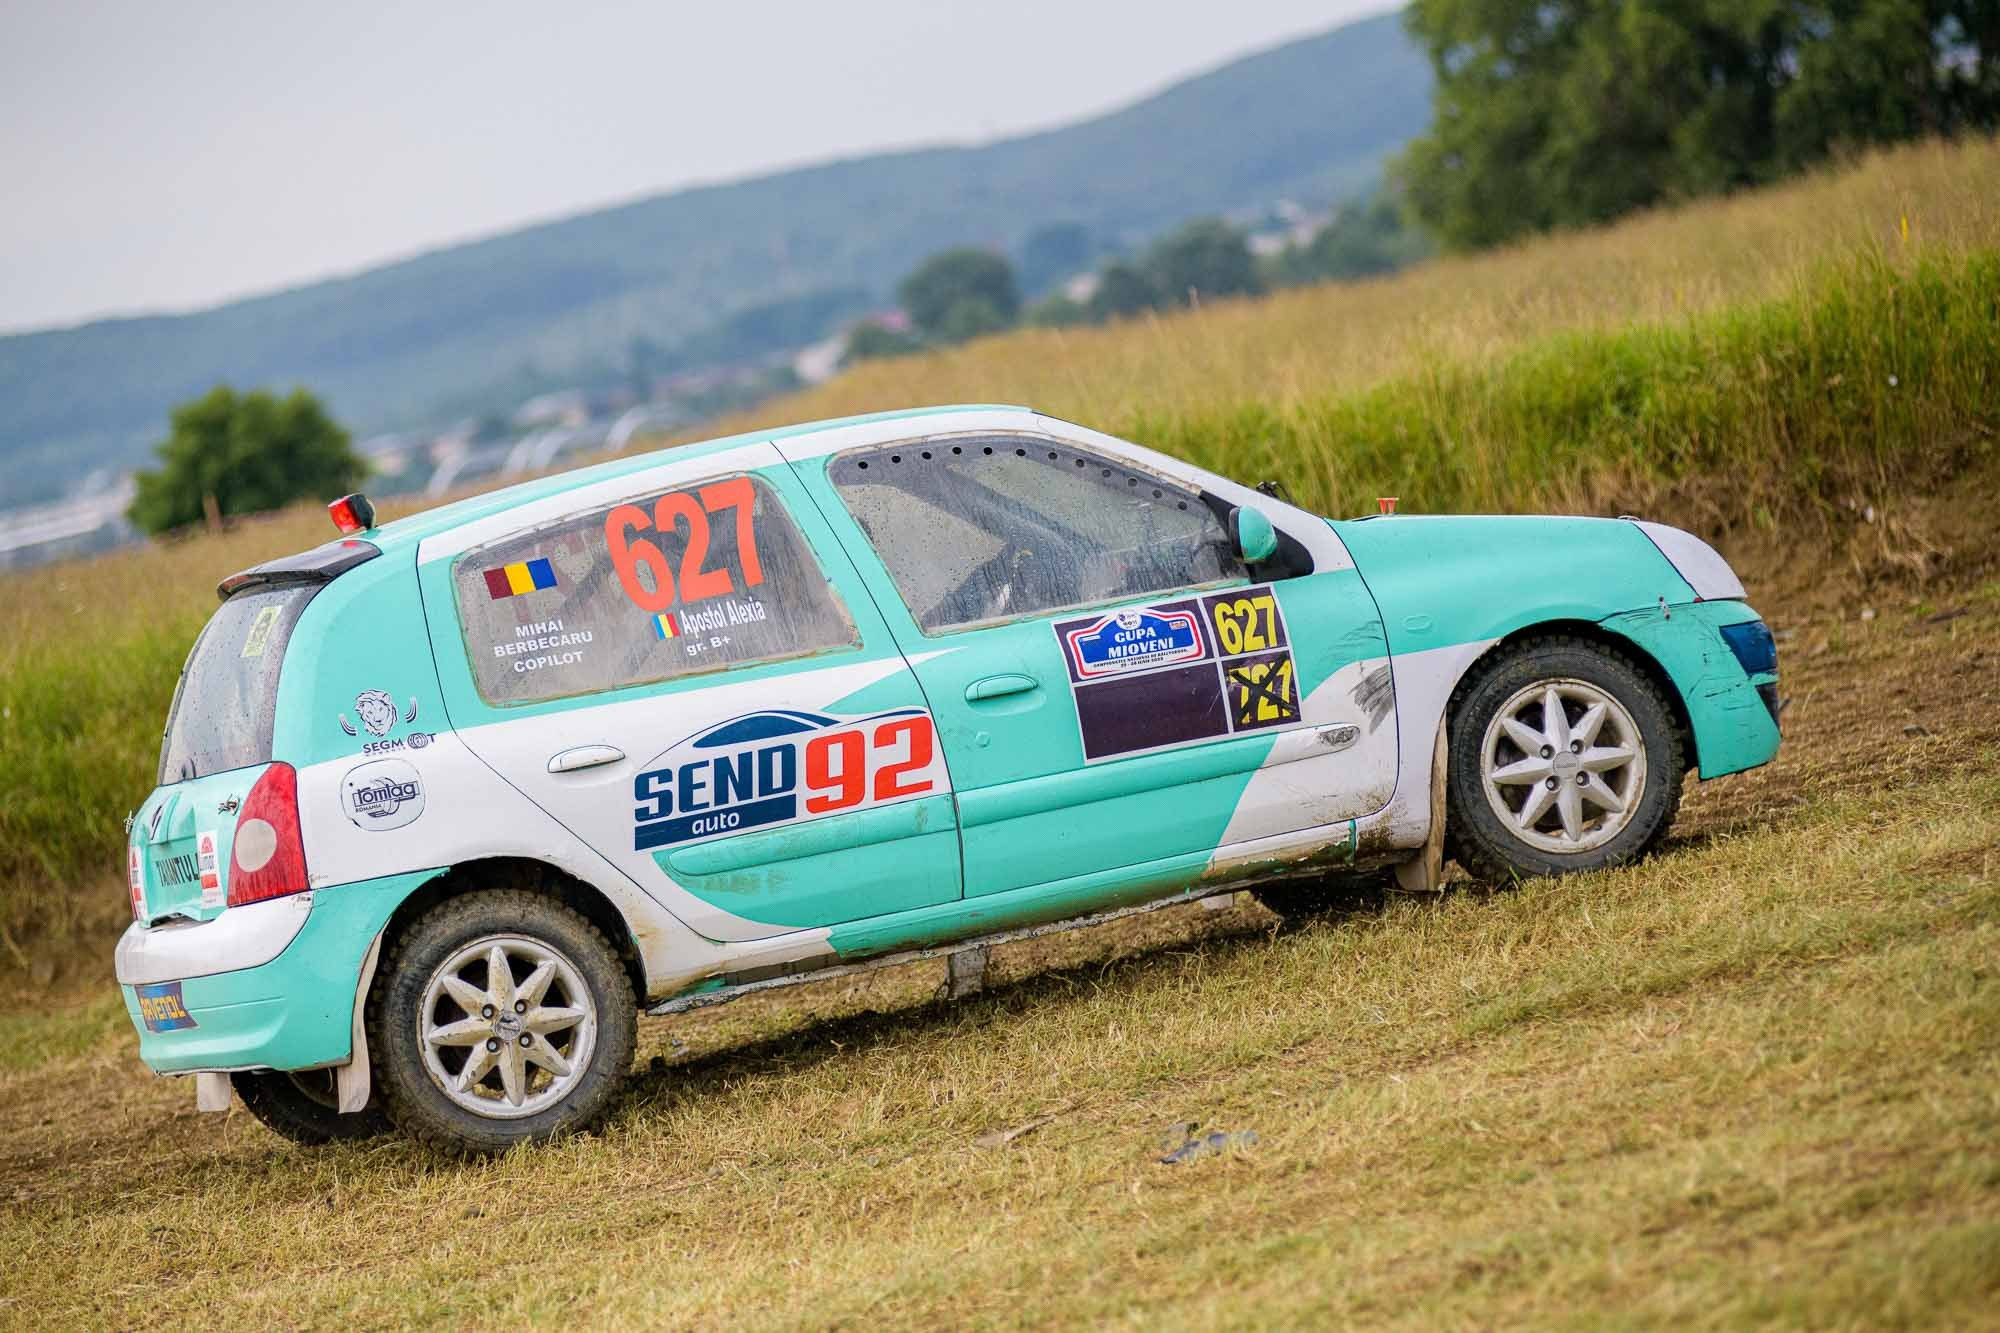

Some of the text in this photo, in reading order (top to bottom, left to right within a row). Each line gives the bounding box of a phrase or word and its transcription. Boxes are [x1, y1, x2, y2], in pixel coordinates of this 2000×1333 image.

[603, 476, 765, 613] 627
[680, 596, 766, 639] Apostol Alexia
[1214, 595, 1277, 655] 627
[515, 620, 564, 638] MIHAI
[1114, 627, 1157, 643] CUPA
[494, 632, 593, 657] BERBECARU
[686, 636, 731, 656] gr. B+
[1108, 637, 1174, 659] MIOVENI
[514, 651, 583, 673] COPILOT
[634, 716, 933, 822] SEND 92
[692, 812, 740, 834] auto
